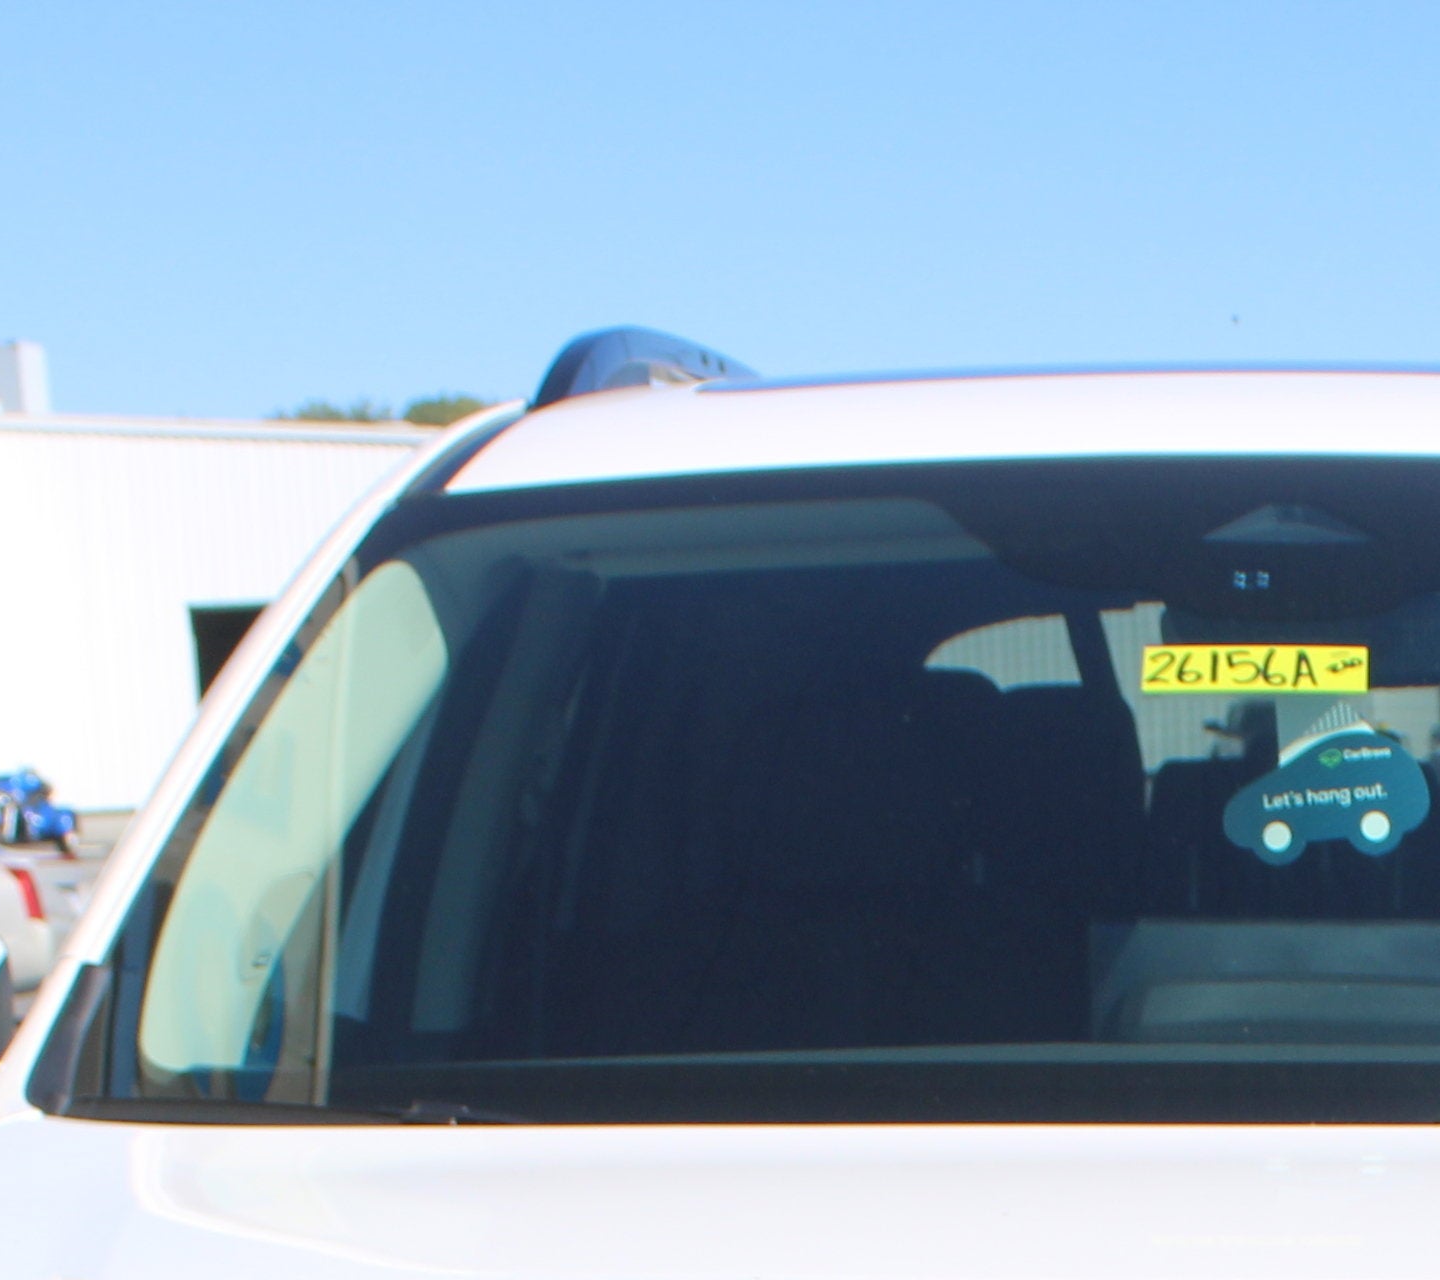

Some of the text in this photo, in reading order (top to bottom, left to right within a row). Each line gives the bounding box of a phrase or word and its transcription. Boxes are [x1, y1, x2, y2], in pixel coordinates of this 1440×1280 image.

[1145, 648, 1319, 688] 26156A
[1263, 782, 1388, 811] Let's hang out.
